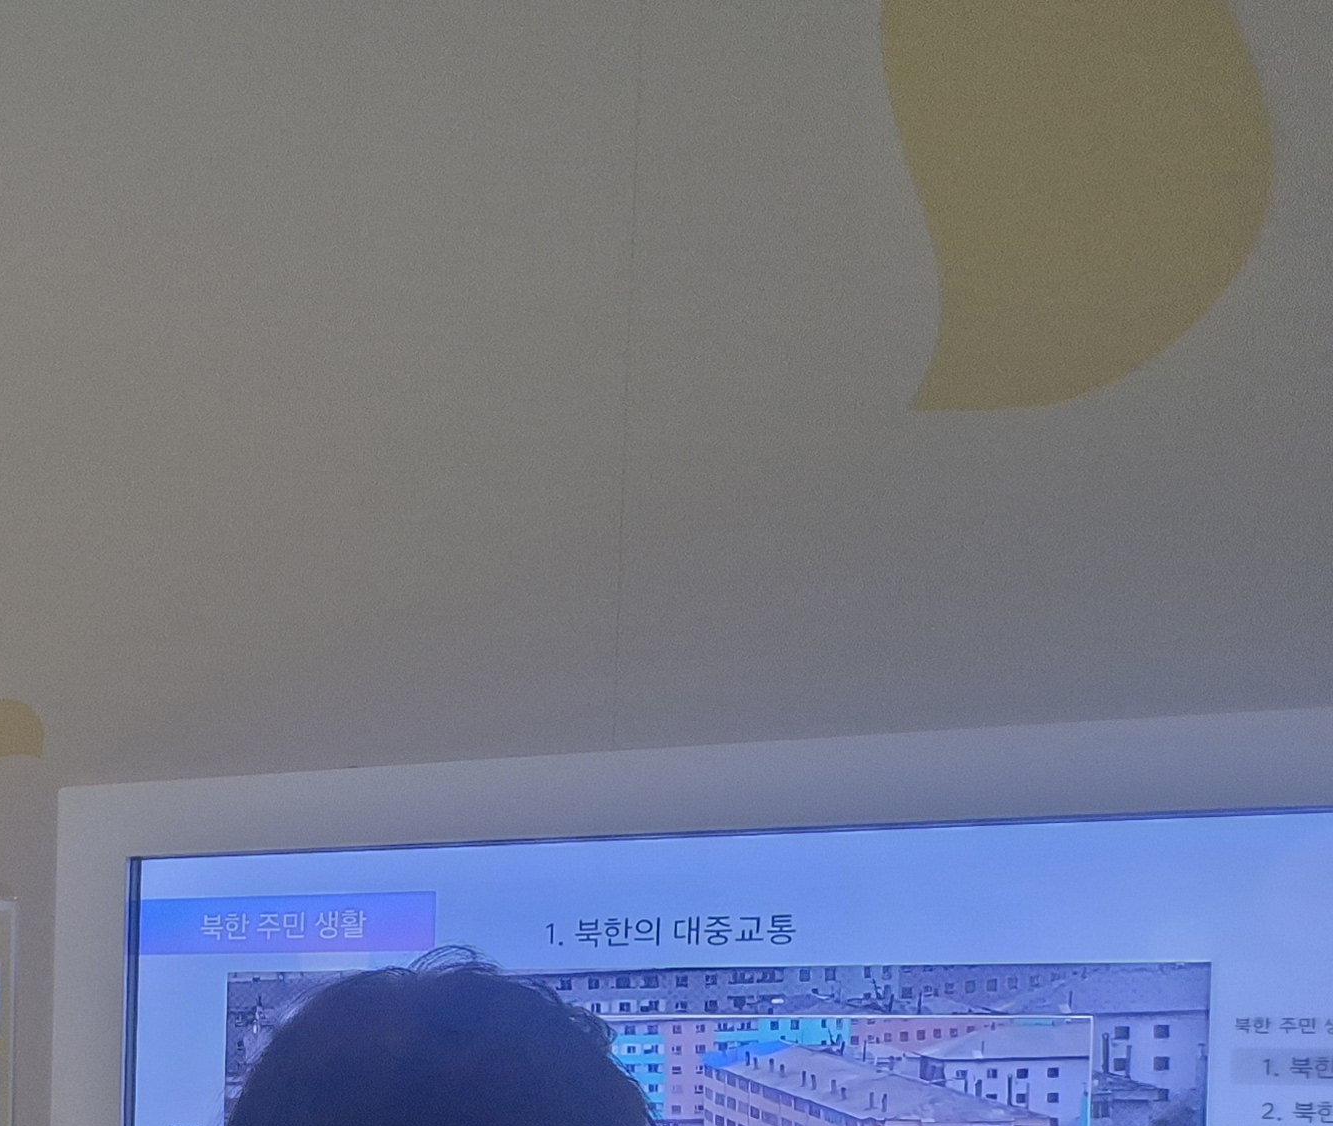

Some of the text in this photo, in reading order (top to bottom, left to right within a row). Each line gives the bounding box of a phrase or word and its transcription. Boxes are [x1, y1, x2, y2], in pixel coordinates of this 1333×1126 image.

[200, 908, 367, 942] 북한 주민 생활
[545, 913, 798, 947] 1. 북한의 대중교통
[1235, 1017, 1271, 1035] 북한
[1279, 1017, 1316, 1035] 주민
[1262, 1058, 1280, 1078] 1.
[1261, 1102, 1283, 1122] 2.
